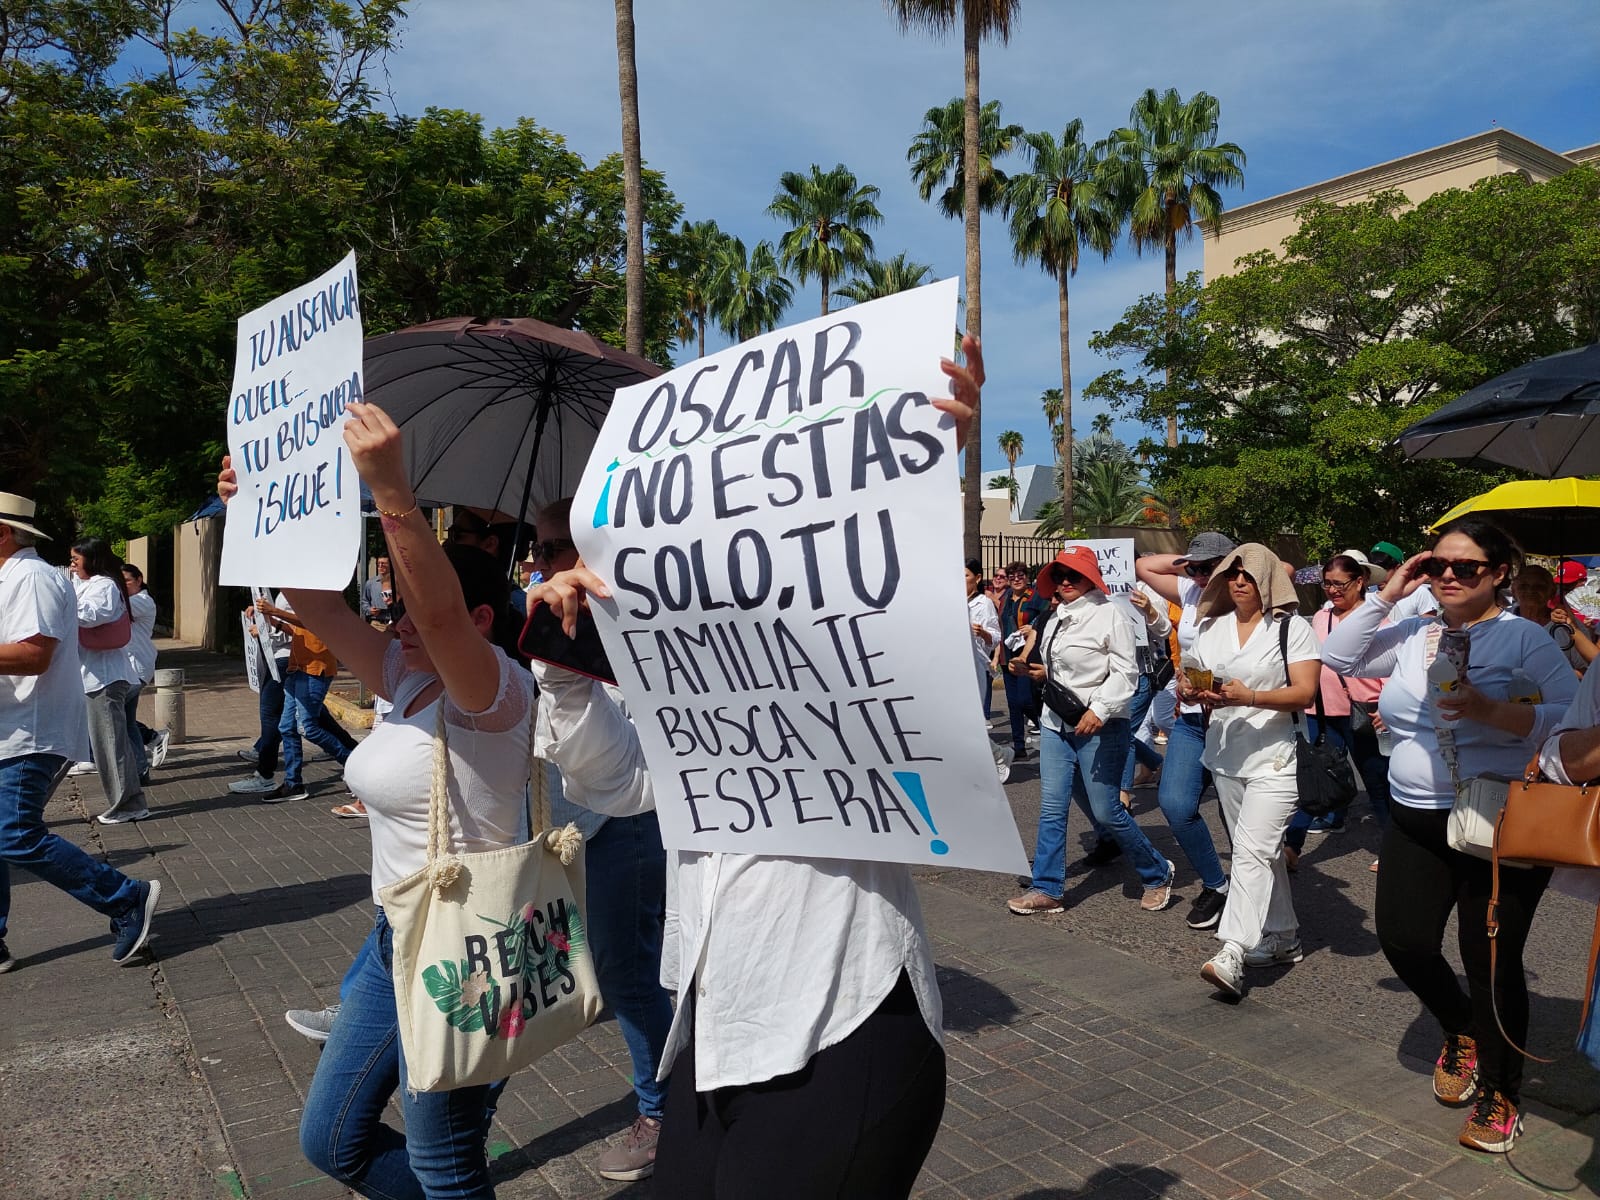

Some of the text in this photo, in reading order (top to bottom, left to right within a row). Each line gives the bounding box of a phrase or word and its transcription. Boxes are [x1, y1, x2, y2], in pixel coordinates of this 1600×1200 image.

[249, 268, 360, 373] TU AUSENCIA
[240, 371, 363, 476] TU BUSQUEDA
[627, 321, 865, 454] OSCAR
[253, 446, 343, 539] ¡SIGUE!
[592, 391, 945, 529] ¡NO ESTAS
[780, 508, 902, 611] TU
[1094, 546, 1121, 561] LVE
[621, 610, 895, 696] FAMILIA TE
[655, 696, 944, 765] BUSCA Y TE
[678, 765, 950, 857] ESPERA!
